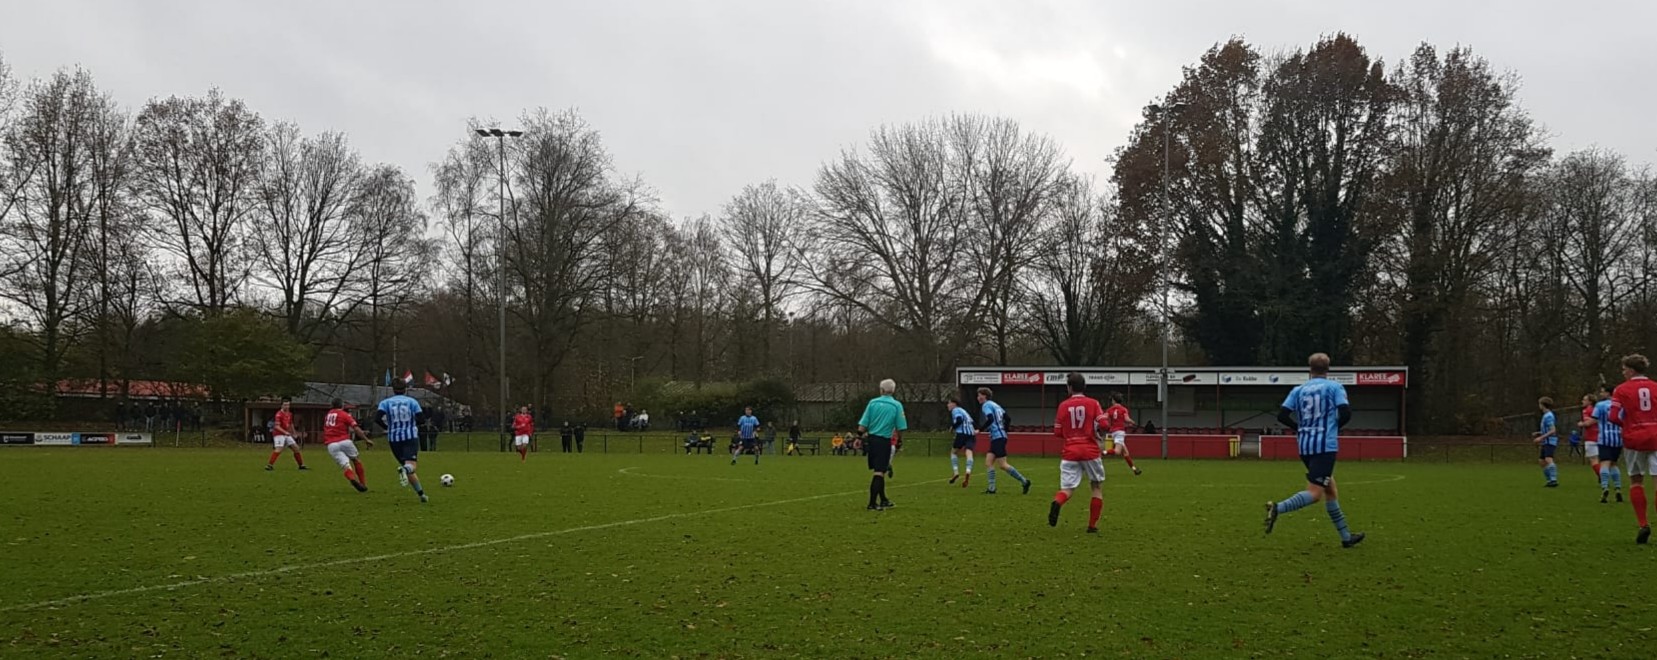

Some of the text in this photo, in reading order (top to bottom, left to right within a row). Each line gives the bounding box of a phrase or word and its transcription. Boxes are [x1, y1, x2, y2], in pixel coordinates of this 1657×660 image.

[1638, 387, 1652, 412] 8
[325, 413, 338, 427] 10
[1068, 405, 1086, 429] 19
